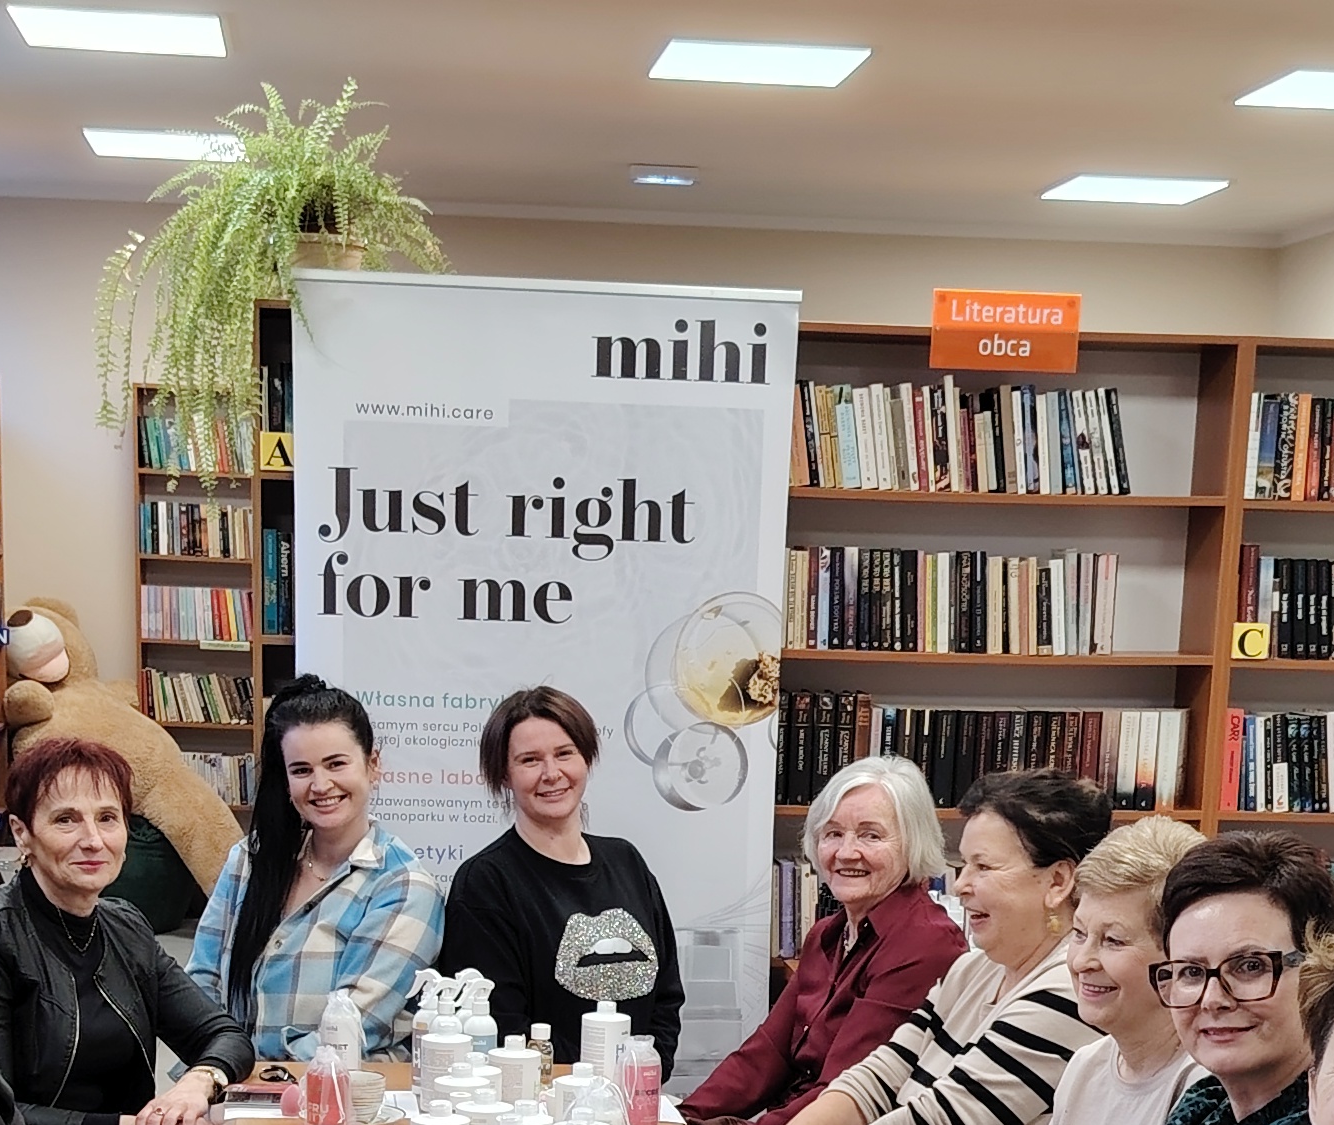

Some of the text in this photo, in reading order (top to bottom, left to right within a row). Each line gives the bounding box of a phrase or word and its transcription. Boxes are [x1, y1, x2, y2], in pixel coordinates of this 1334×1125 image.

[951, 299, 1064, 326] Literatura
[590, 318, 770, 385] mihi
[978, 334, 1031, 357] obca
[355, 402, 494, 421] www.mihi.care
[265, 437, 293, 467] A
[318, 466, 696, 563] Just right
[280, 540, 291, 577] Ahern
[318, 551, 574, 625] for me
[1238, 628, 1264, 658] C
[356, 690, 435, 709] Własna
[370, 721, 459, 734] samym sercu
[1228, 713, 1241, 742] CARR
[369, 797, 482, 811] zaawansowanym
[463, 812, 498, 824] Łodzi.
